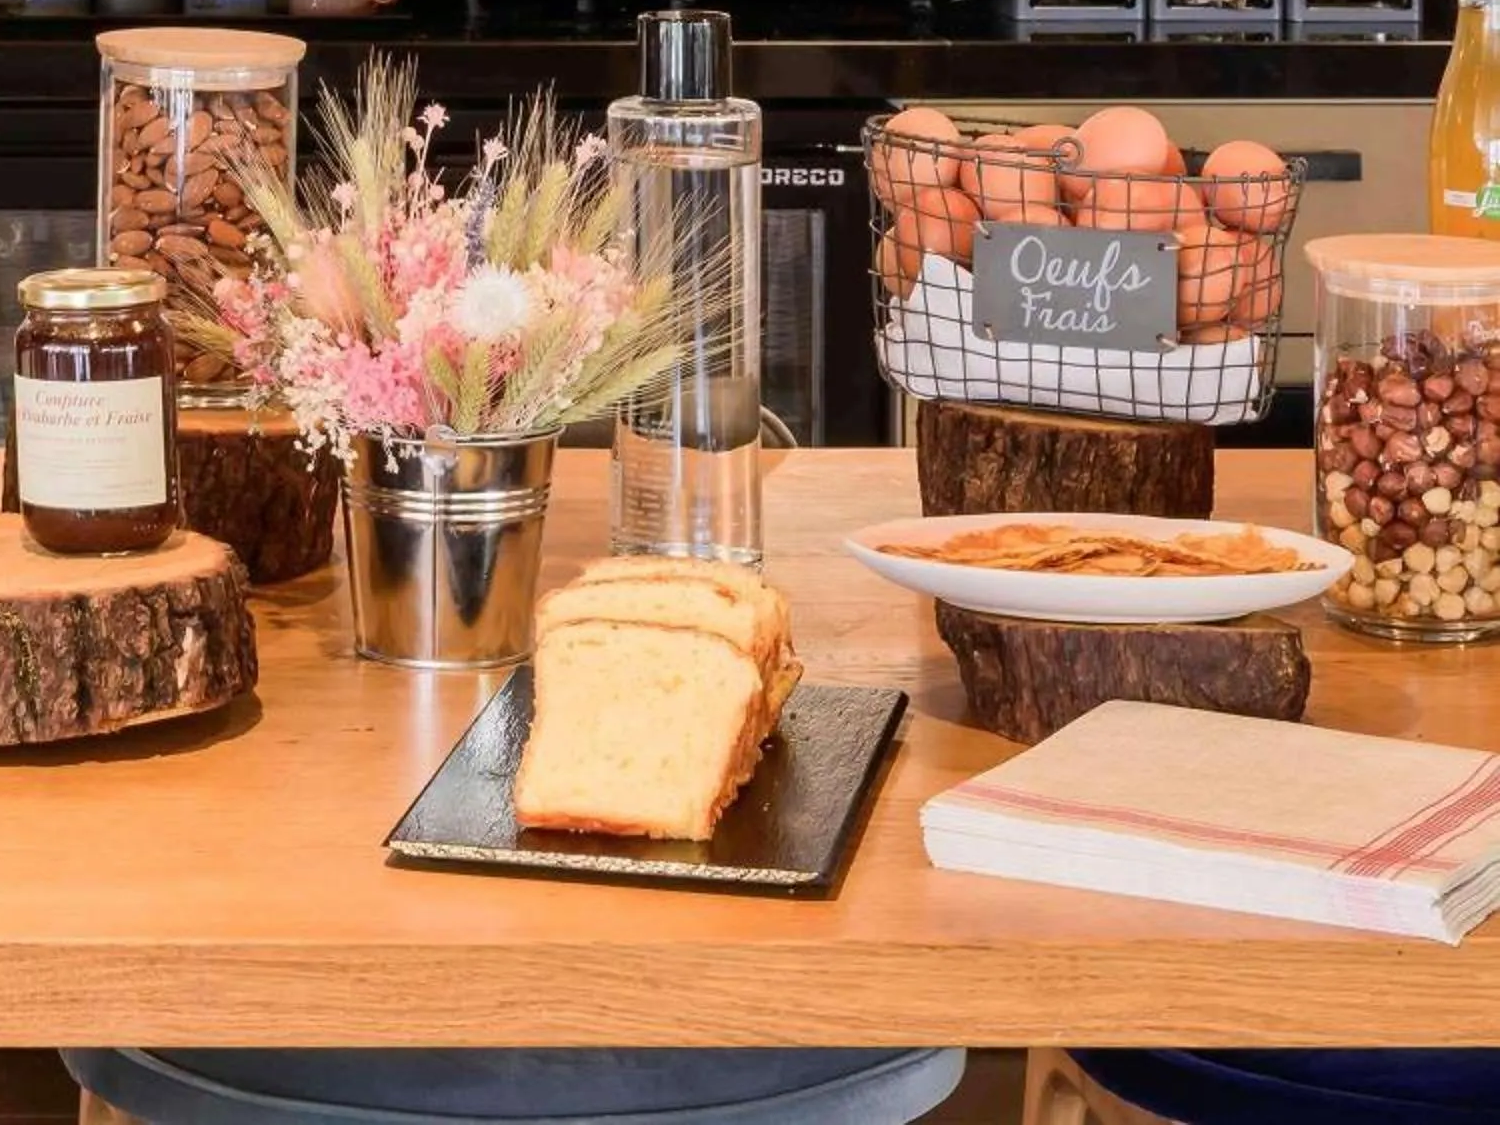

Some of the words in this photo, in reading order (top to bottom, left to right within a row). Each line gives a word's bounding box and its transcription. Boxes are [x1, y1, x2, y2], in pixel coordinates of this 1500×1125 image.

[1010, 235, 1152, 312] Oeufs
[1020, 286, 1118, 334] Frais
[35, 390, 105, 410] Confiture
[85, 414, 100, 427] et
[106, 410, 154, 426] Fraise
